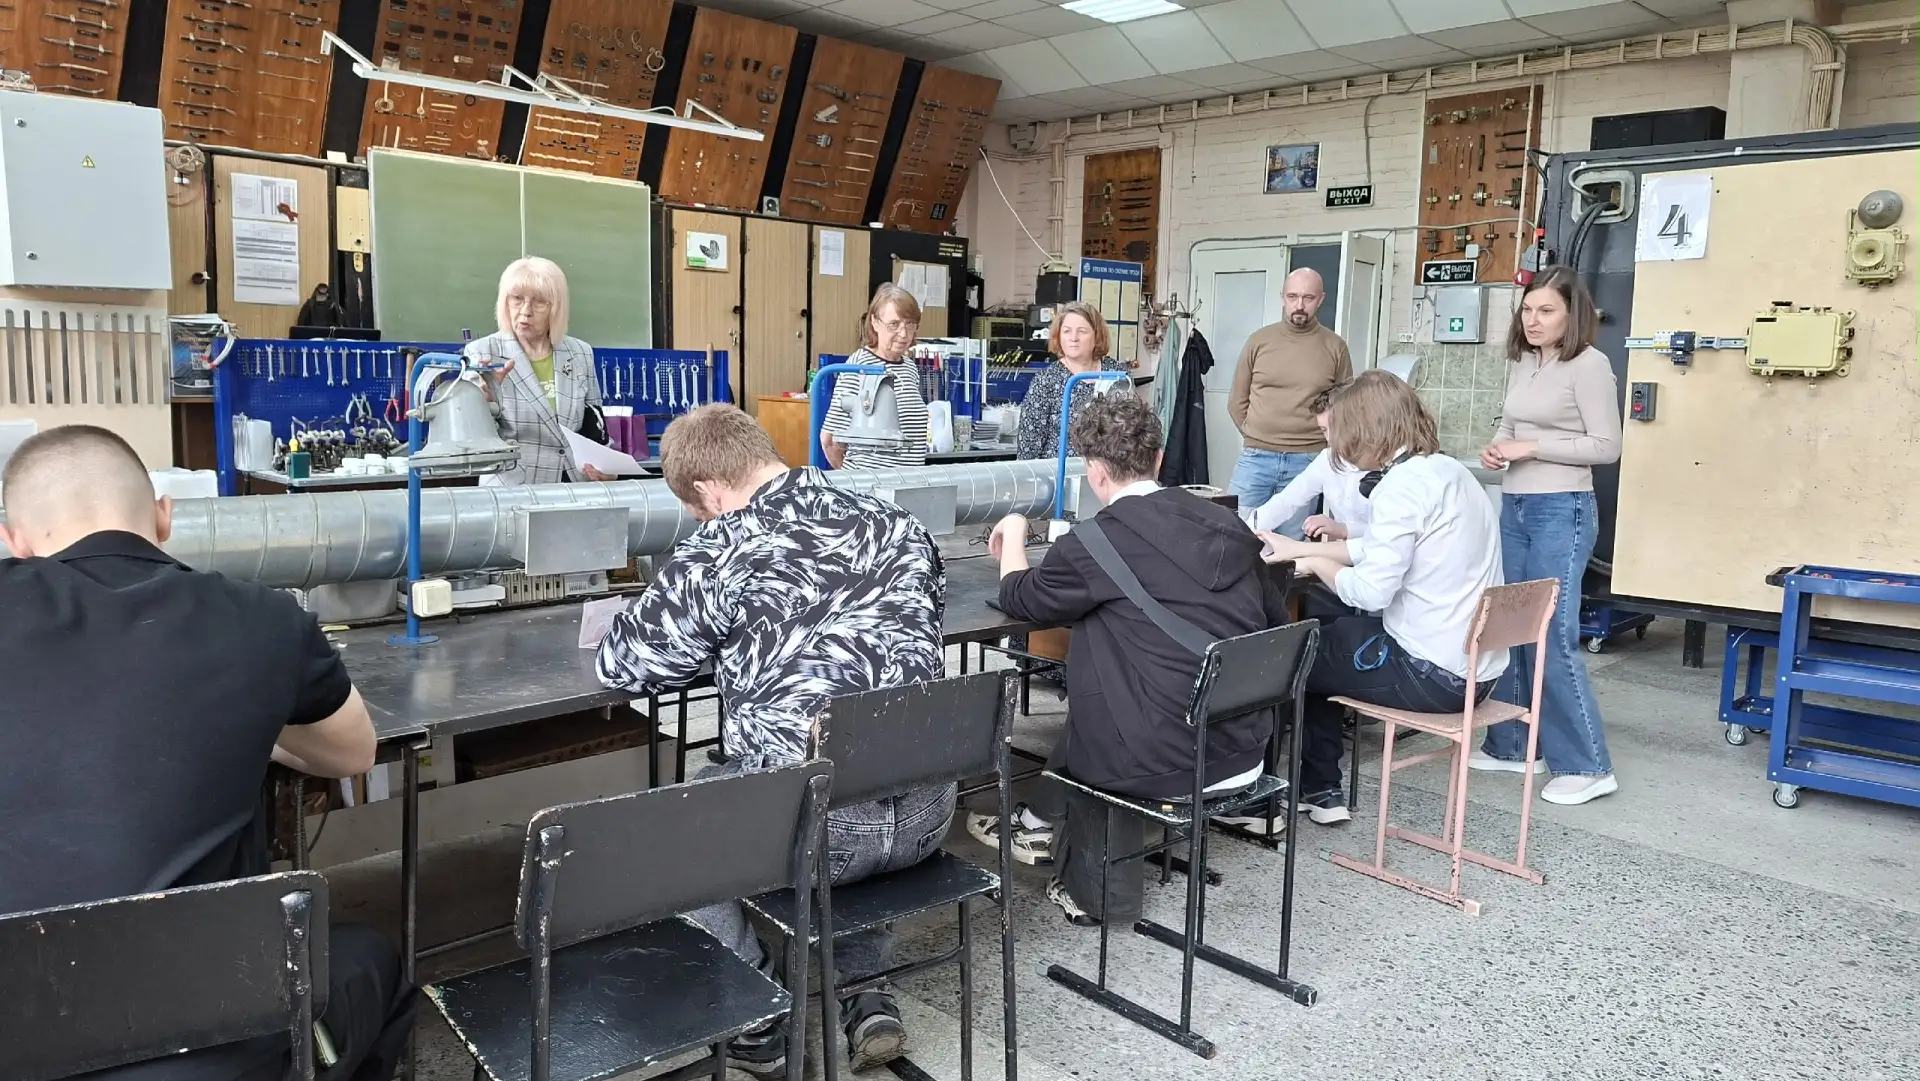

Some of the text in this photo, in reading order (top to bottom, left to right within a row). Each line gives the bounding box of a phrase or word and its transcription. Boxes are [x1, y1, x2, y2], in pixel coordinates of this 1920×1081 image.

[1329, 187, 1368, 199] ВЫХОД
[1657, 204, 1693, 247] 4
[1451, 265, 1471, 273] ВЫХОД
